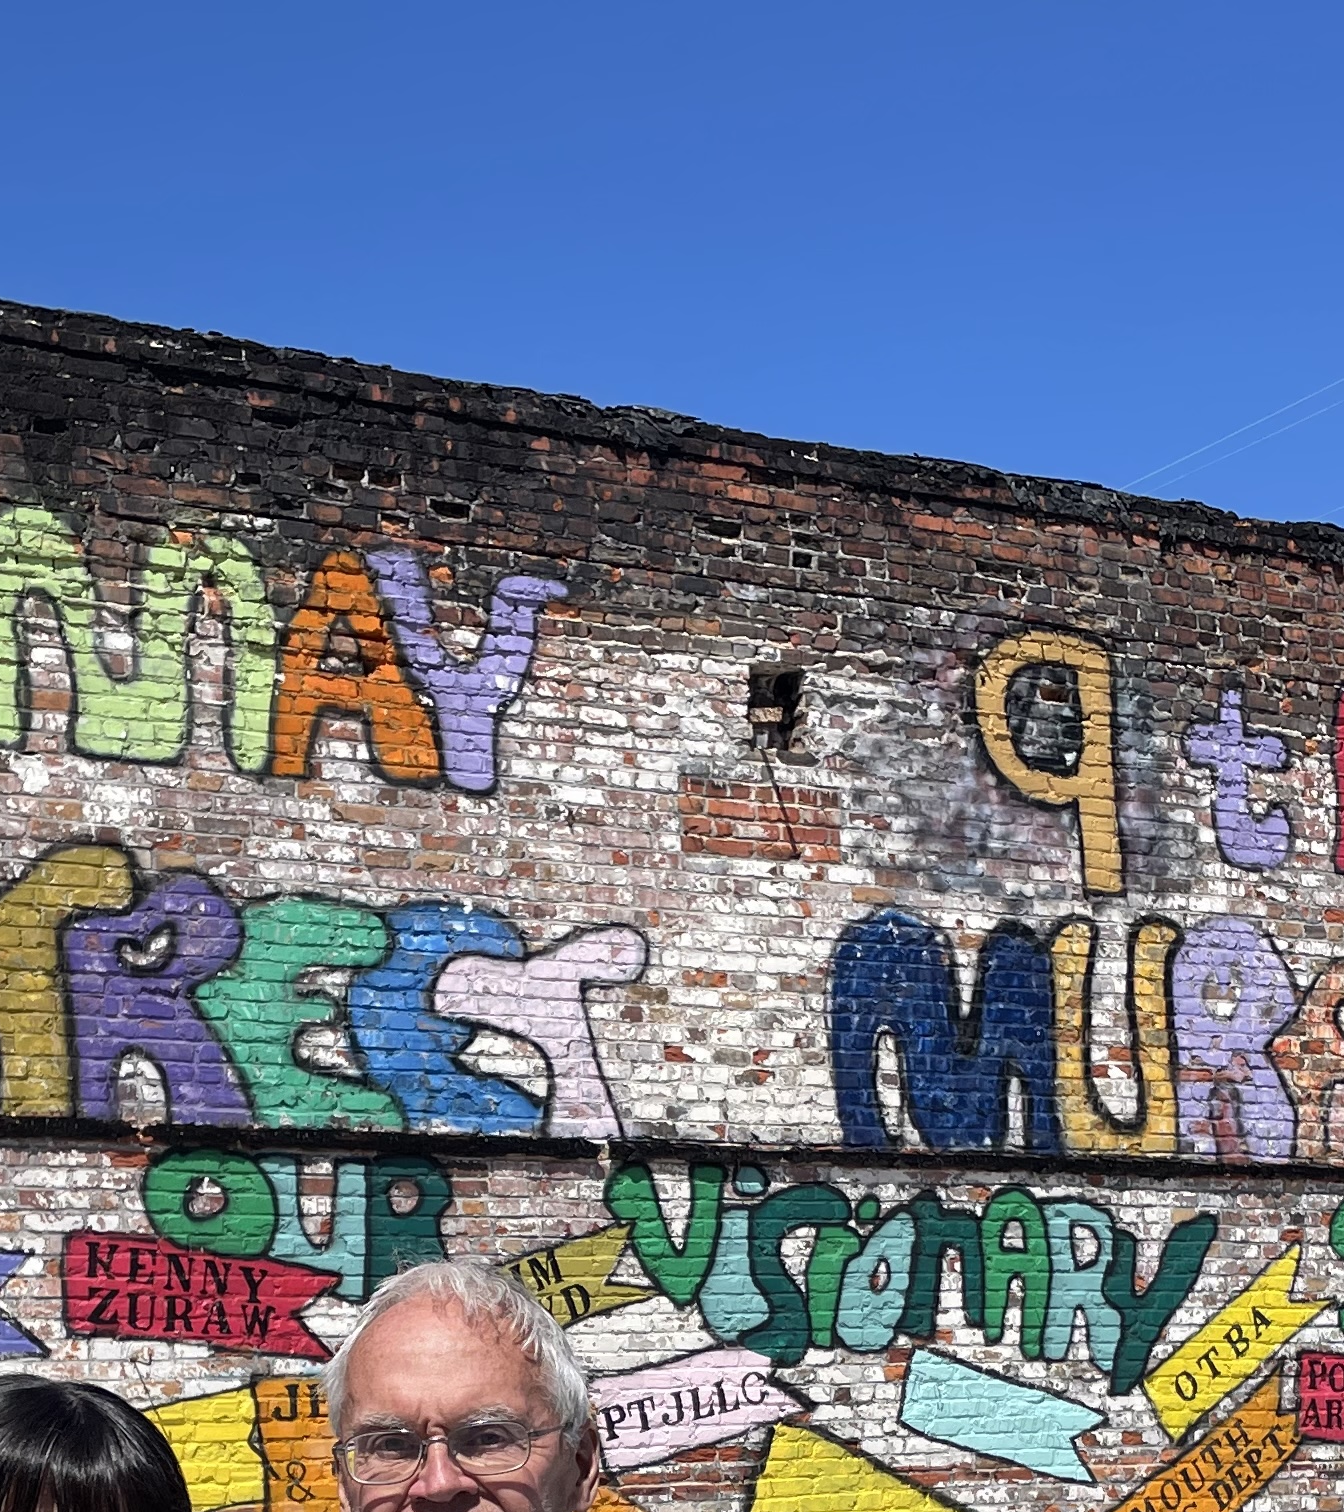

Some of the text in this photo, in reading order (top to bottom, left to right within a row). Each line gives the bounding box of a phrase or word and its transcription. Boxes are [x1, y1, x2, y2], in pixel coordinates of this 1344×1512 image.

[142, 1150, 453, 1304] OUR
[86, 1241, 269, 1305] KENNY
[88, 1287, 278, 1341] ZURAW
[1172, 1303, 1274, 1402] OTBA
